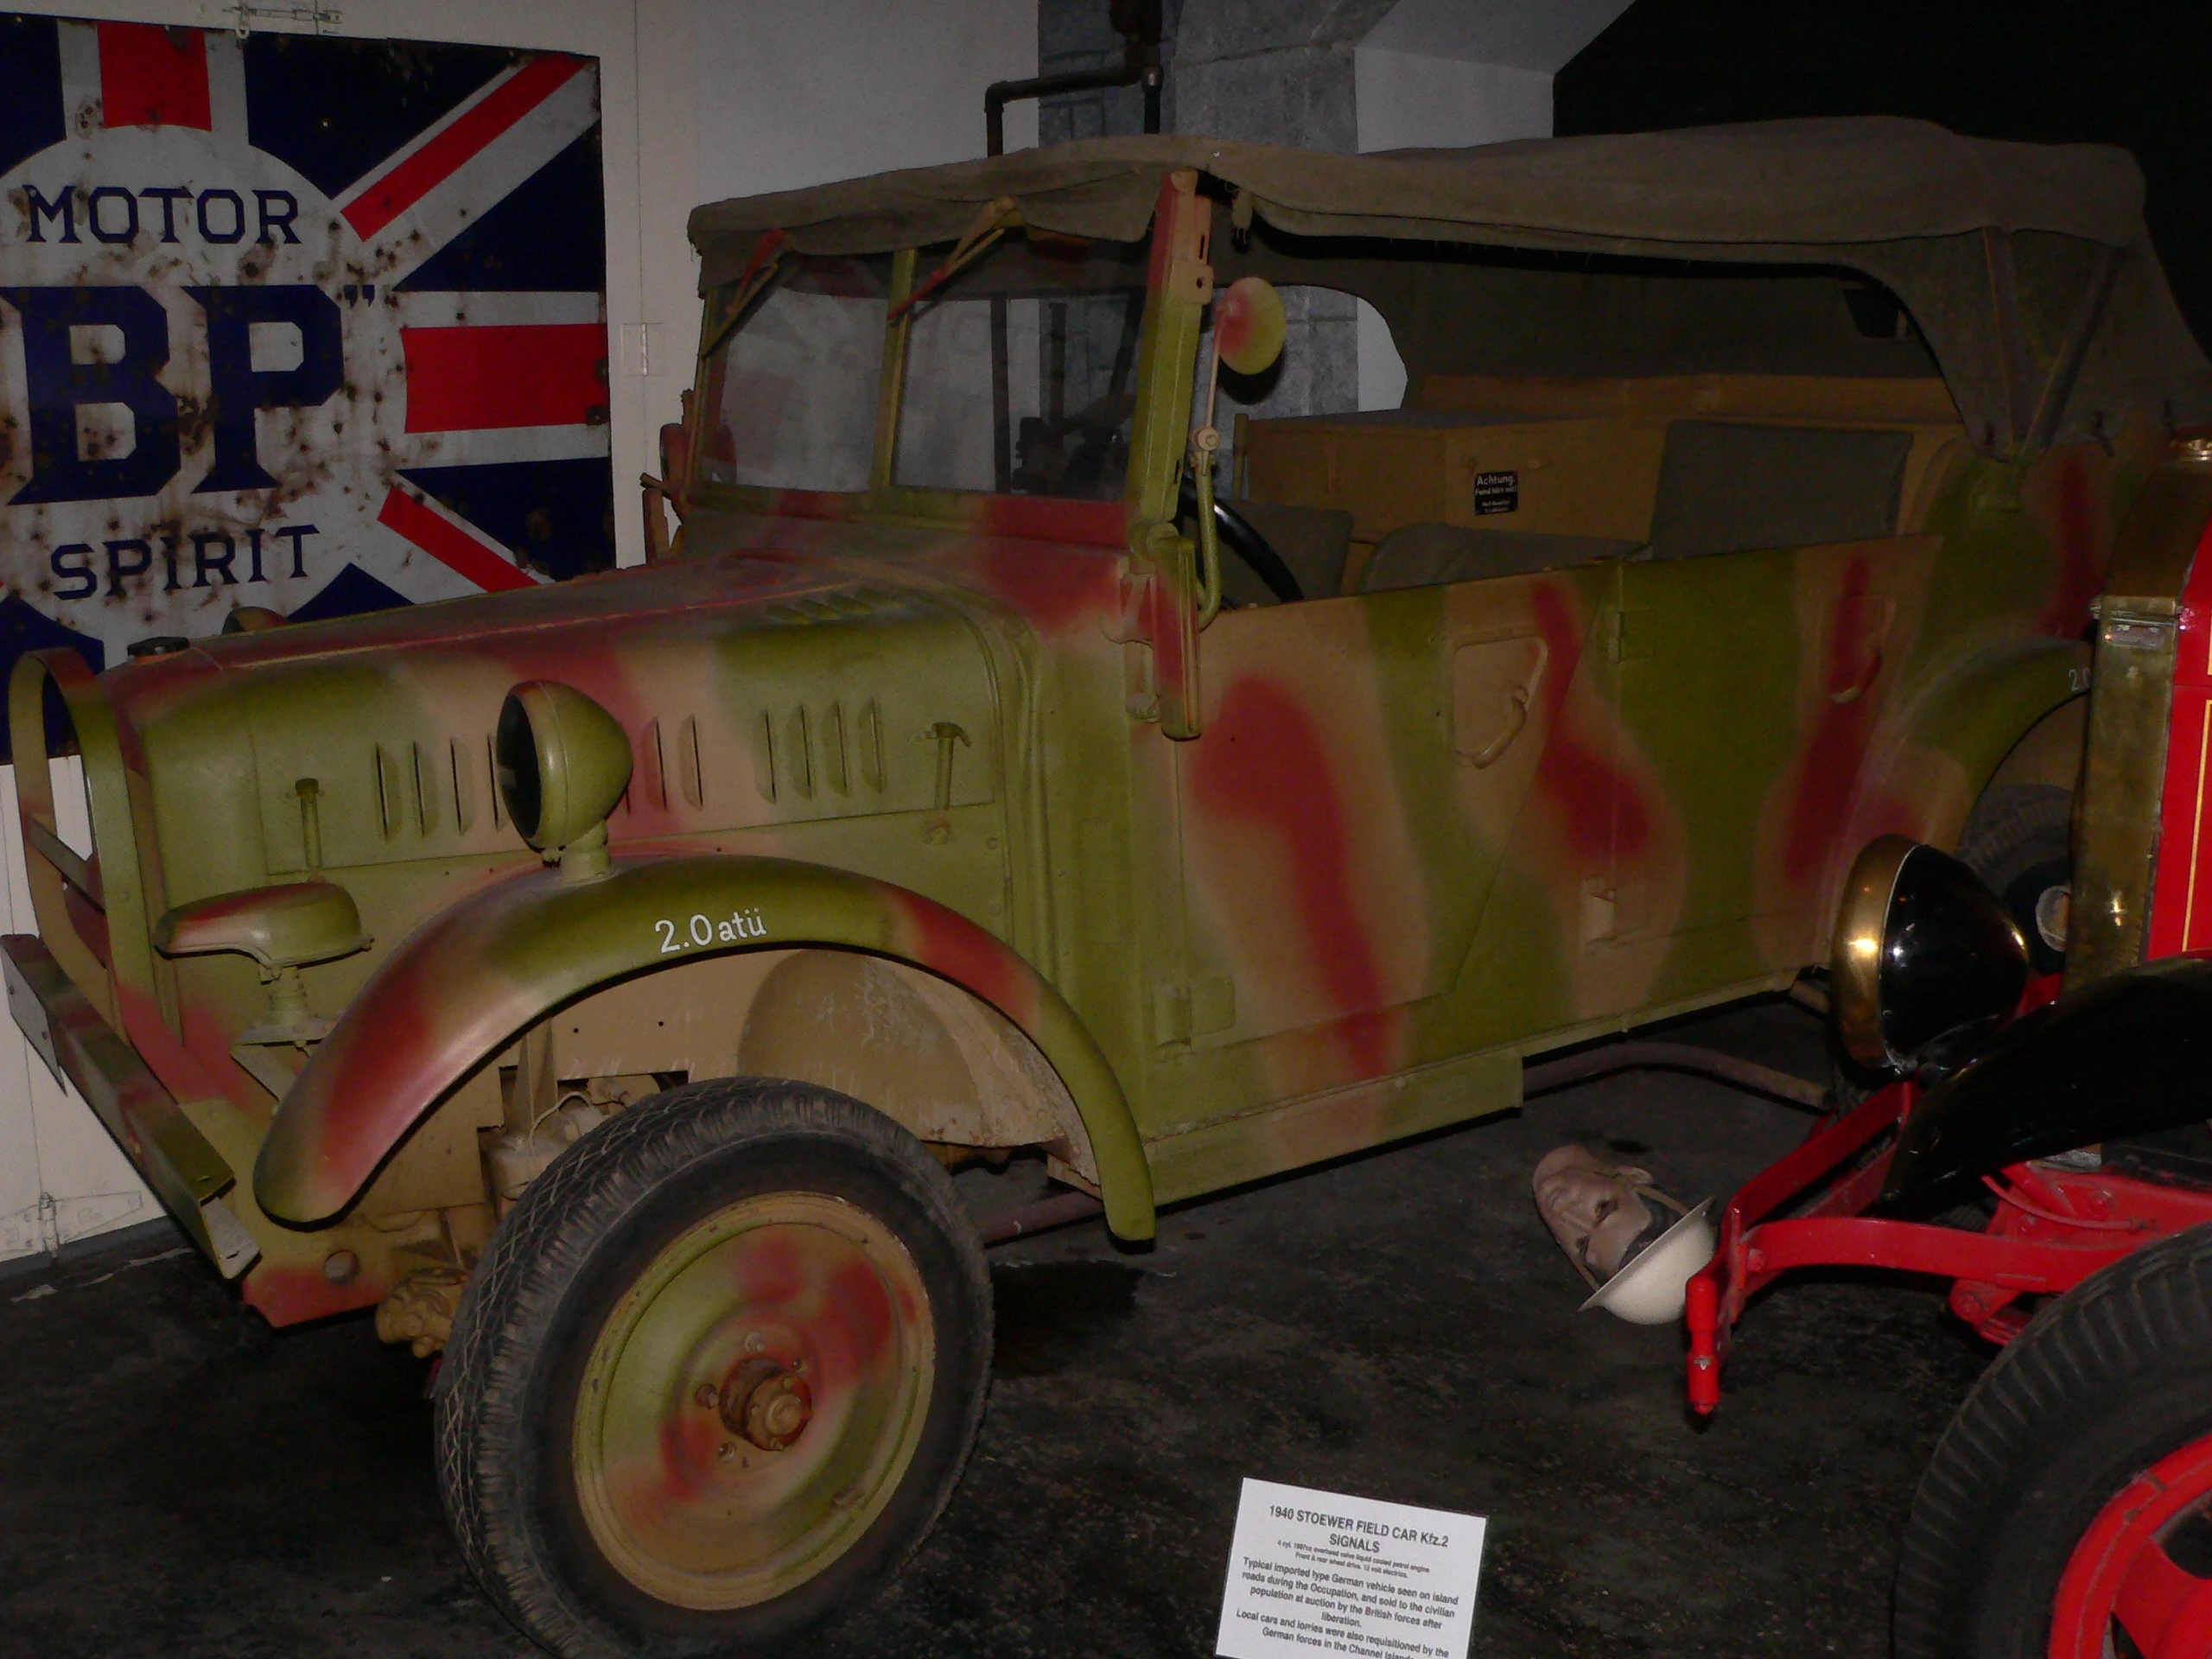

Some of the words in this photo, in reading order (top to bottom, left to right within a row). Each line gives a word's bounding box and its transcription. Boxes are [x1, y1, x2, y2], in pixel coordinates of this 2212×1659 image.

[25, 185, 302, 245] MOTOR
[50, 524, 321, 601] SPIRIT
[1269, 1504, 1294, 1520] 1940
[1296, 1510, 1354, 1530] STOEWER
[1356, 1520, 1389, 1537] FIELD
[1392, 1526, 1418, 1542] CAR
[1329, 1533, 1381, 1554] SIGNALS
[1243, 1556, 1273, 1571] Typical
[1274, 1562, 1311, 1578] imported
[1312, 1570, 1330, 1582] type
[1332, 1573, 1364, 1588] German
[1366, 1581, 1395, 1594] vehicle
[1397, 1587, 1418, 1598] seen
[1419, 1592, 1431, 1600] on
[1356, 1554, 1372, 1563] liquid
[1410, 1565, 1430, 1573] engine
[1242, 1572, 1266, 1583] roads
[1267, 1574, 1294, 1591] during
[1295, 1580, 1309, 1591] the
[1361, 1593, 1377, 1605] and
[1378, 1597, 1398, 1607] sold
[1398, 1599, 1408, 1610] to
[1409, 1601, 1423, 1612] the
[1424, 1605, 1455, 1618] civilian
[1249, 1586, 1294, 1601] population
[1295, 1594, 1304, 1604] at
[1305, 1597, 1336, 1609] auction
[1337, 1601, 1349, 1614] by
[1350, 1604, 1363, 1615] the
[1364, 1605, 1393, 1620] British
[1394, 1611, 1421, 1626] forces
[1422, 1618, 1443, 1630] after
[1236, 1608, 1259, 1621] Local
[1260, 1614, 1278, 1625] cars
[1279, 1618, 1296, 1629] and
[1297, 1620, 1324, 1635] lorries
[1325, 1627, 1345, 1639] were
[1346, 1630, 1364, 1643] also
[1366, 1636, 1421, 1653] requisitioned
[1422, 1644, 1433, 1657] by
[1435, 1647, 1449, 1658] the
[1321, 1611, 1362, 1628] liberation.
[1262, 1626, 1294, 1642] German
[1296, 1632, 1322, 1647] forces
[1324, 1638, 1332, 1649] in
[1333, 1641, 1347, 1652] the
[1349, 1643, 1383, 1659] Channel
